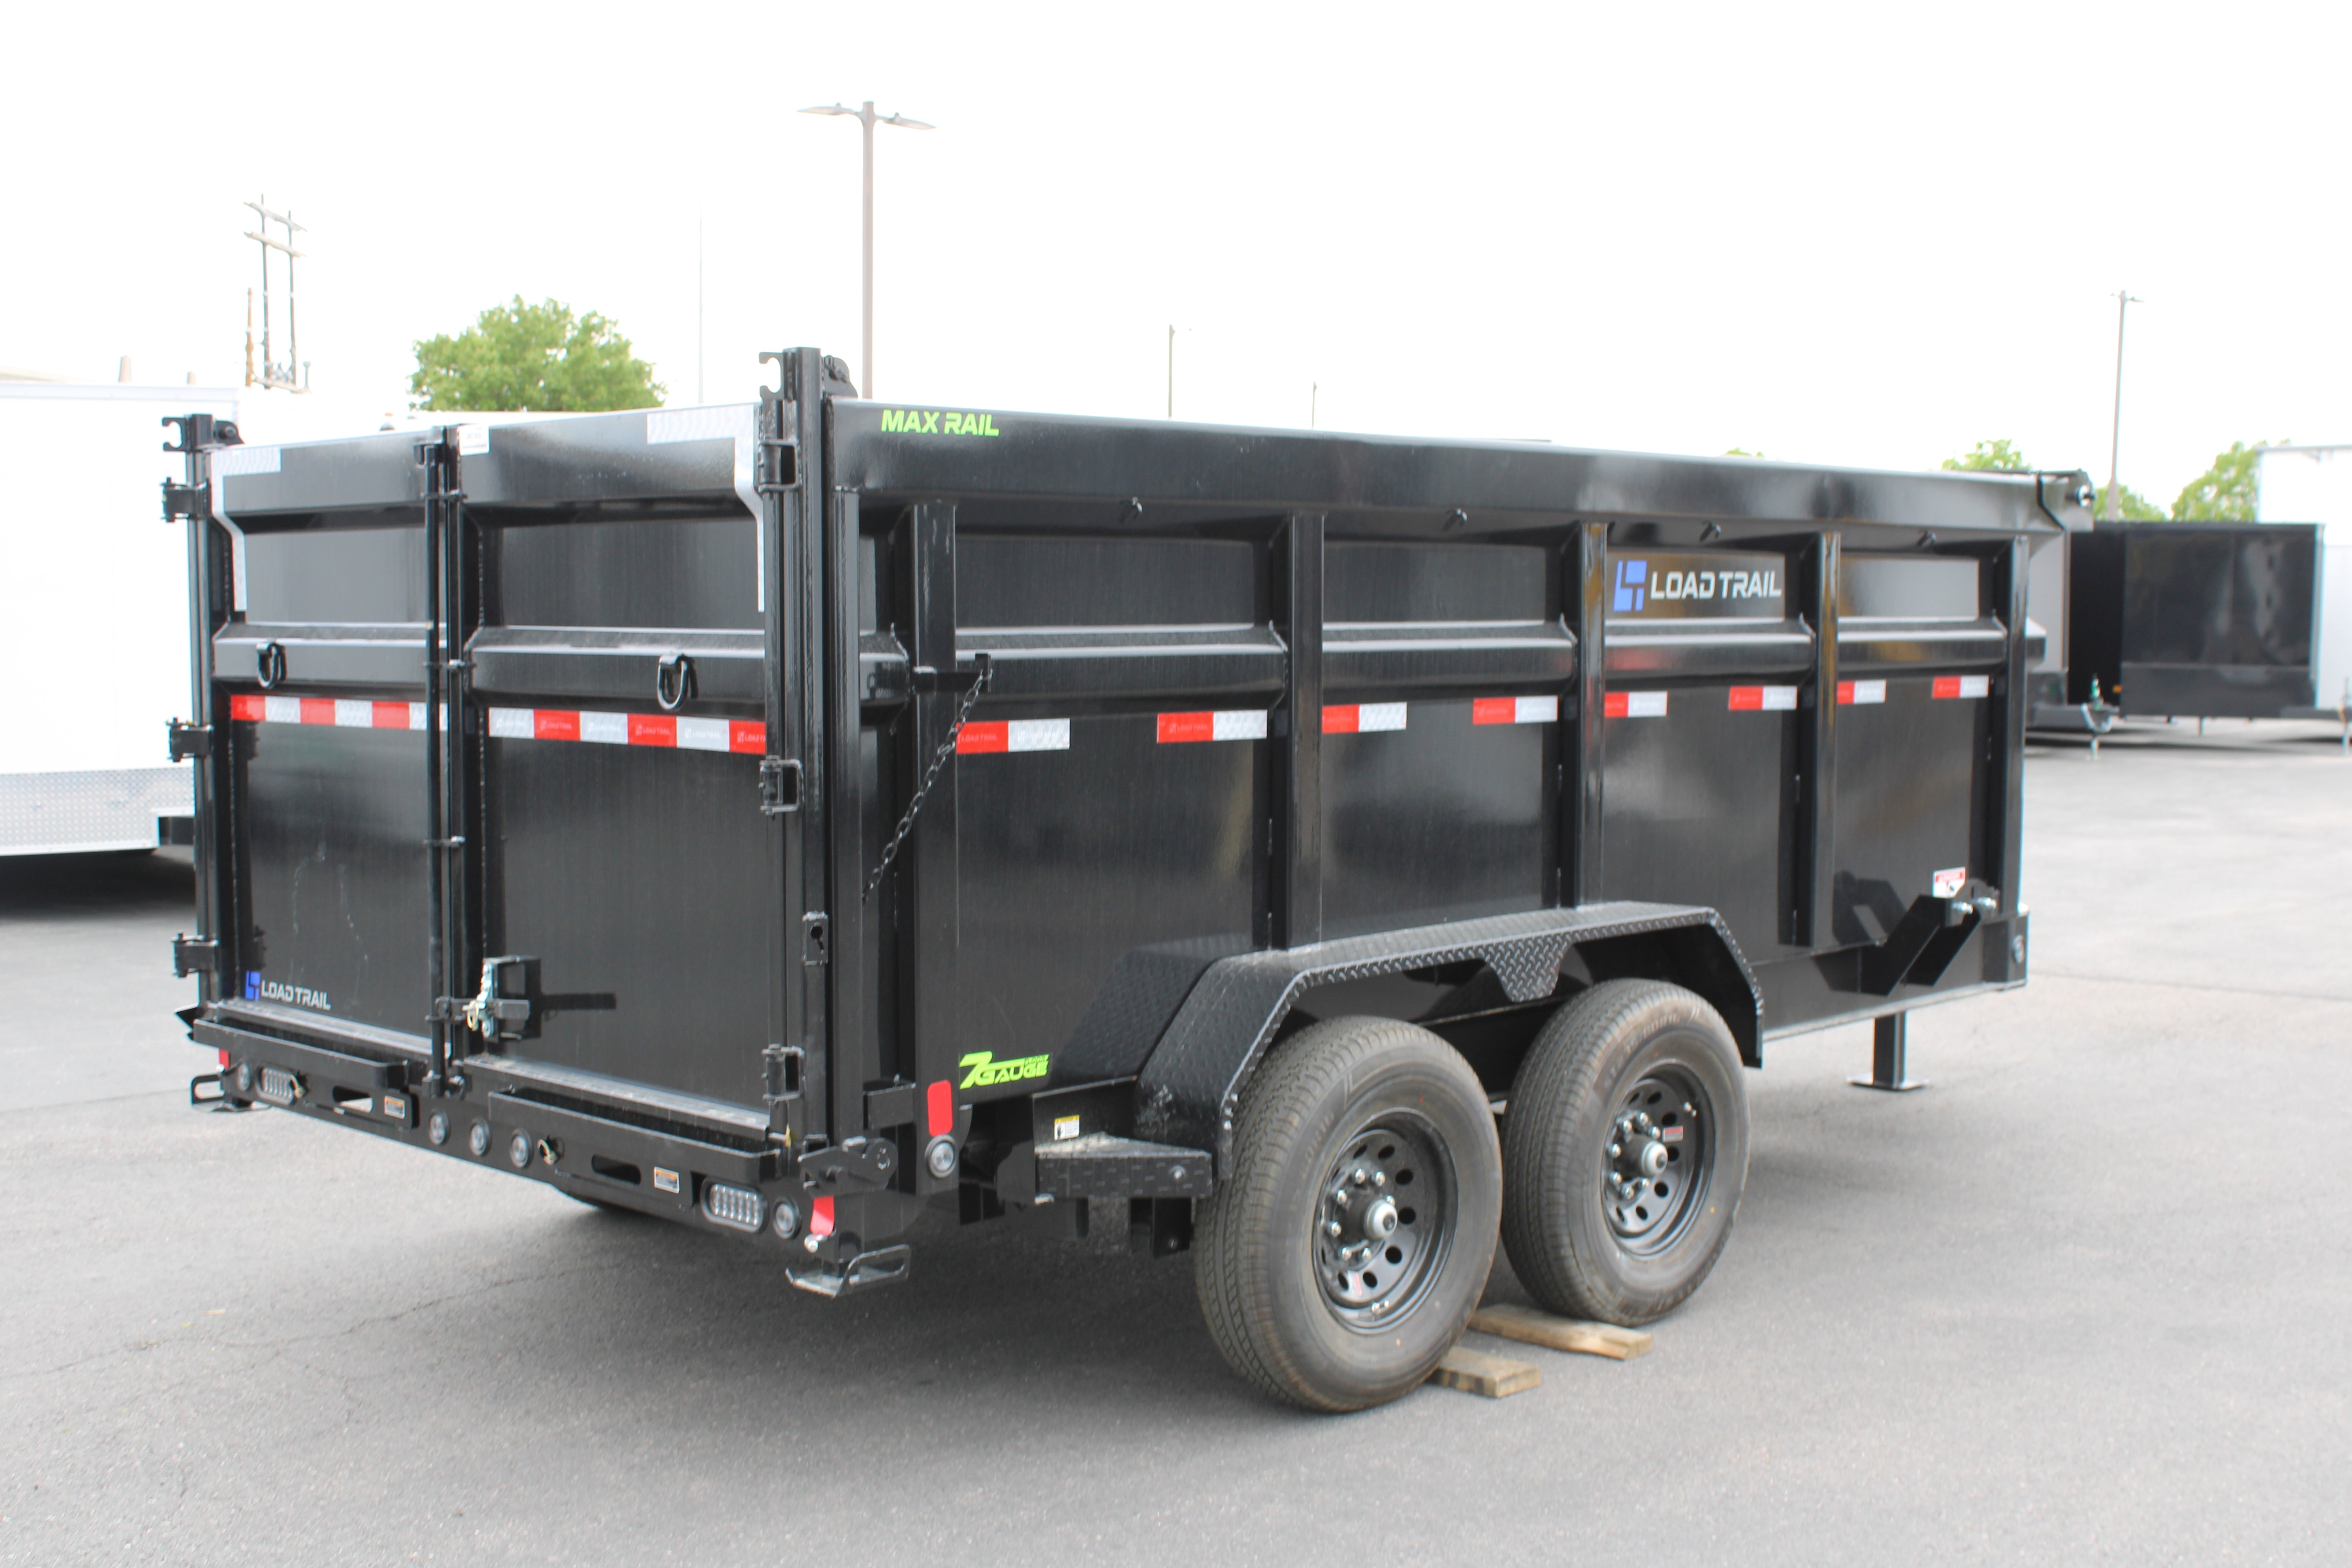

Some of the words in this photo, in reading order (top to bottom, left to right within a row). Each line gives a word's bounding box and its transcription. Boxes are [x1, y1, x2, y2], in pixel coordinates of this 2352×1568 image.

[882, 409, 940, 434] MAX
[944, 412, 1000, 437] RAIL
[1650, 571, 1715, 599] LOAD
[1719, 571, 1782, 598] TRAIL
[261, 980, 294, 1003] LOAD
[294, 987, 331, 1011] TRAIL
[959, 1051, 993, 1089] 7
[974, 1054, 1049, 1086] GAUGE
